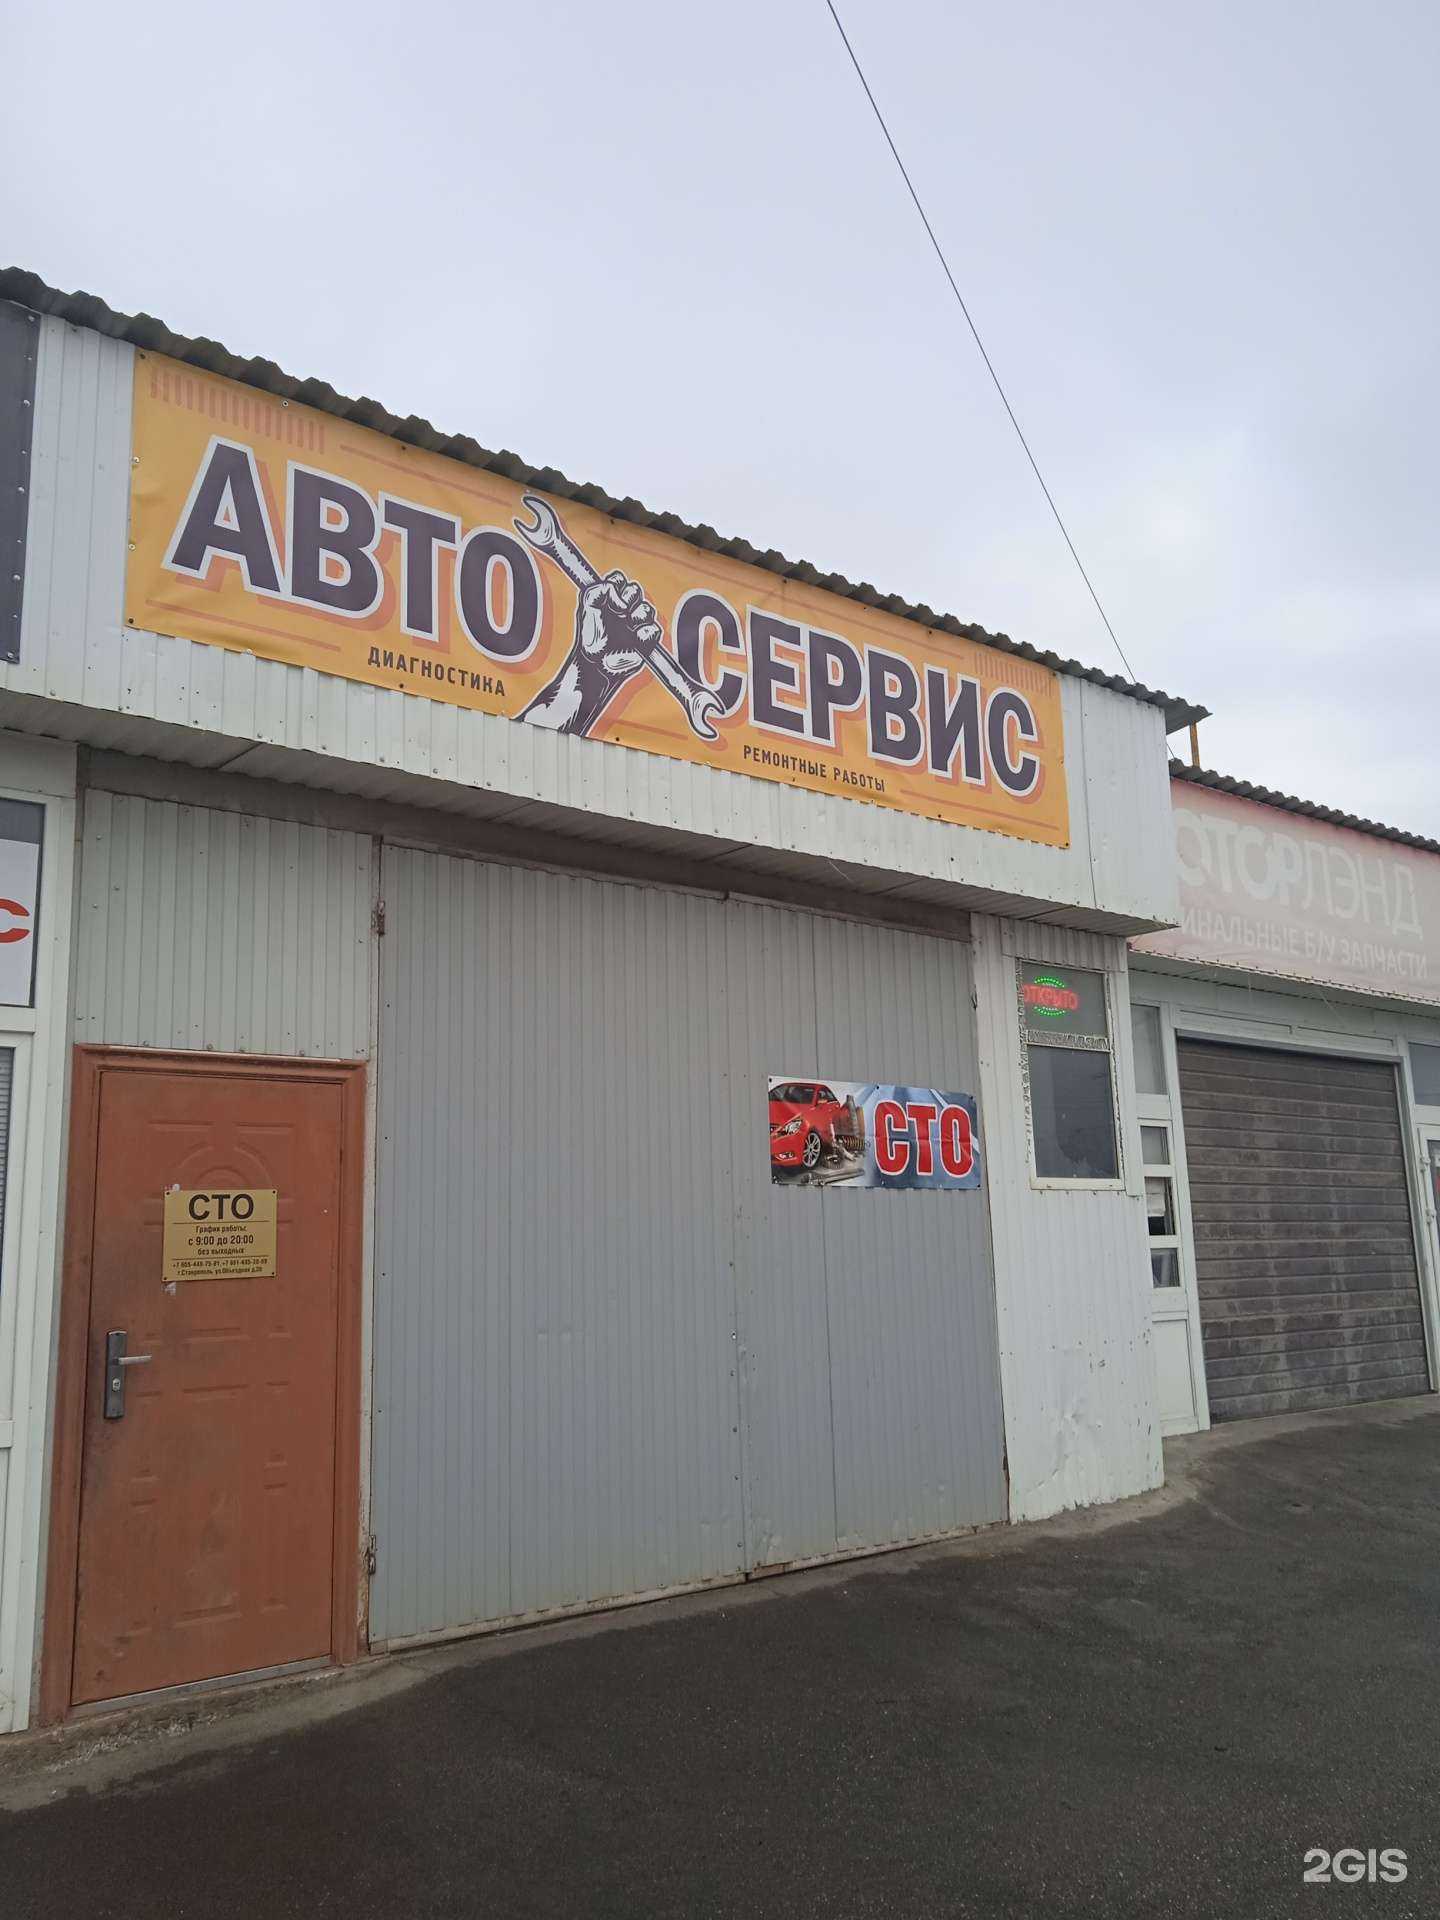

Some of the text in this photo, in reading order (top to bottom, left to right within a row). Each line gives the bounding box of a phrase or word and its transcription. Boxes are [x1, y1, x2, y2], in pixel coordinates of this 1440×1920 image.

[161, 435, 1040, 796] АВТО СЕРВИС
[368, 646, 506, 697] ДИАГНОСТИКА
[743, 744, 886, 793] РЕМОНТНЫЕ РАБОТЫ
[1341, 937, 1428, 979] ЗАПЧАСТИ
[874, 1100, 974, 1178] СТО
[188, 1193, 254, 1220] СТО
[188, 1235, 254, 1247] с 9:00 до 20:00
[196, 1225, 220, 1233] График
[197, 1246, 245, 1256] без выходных
